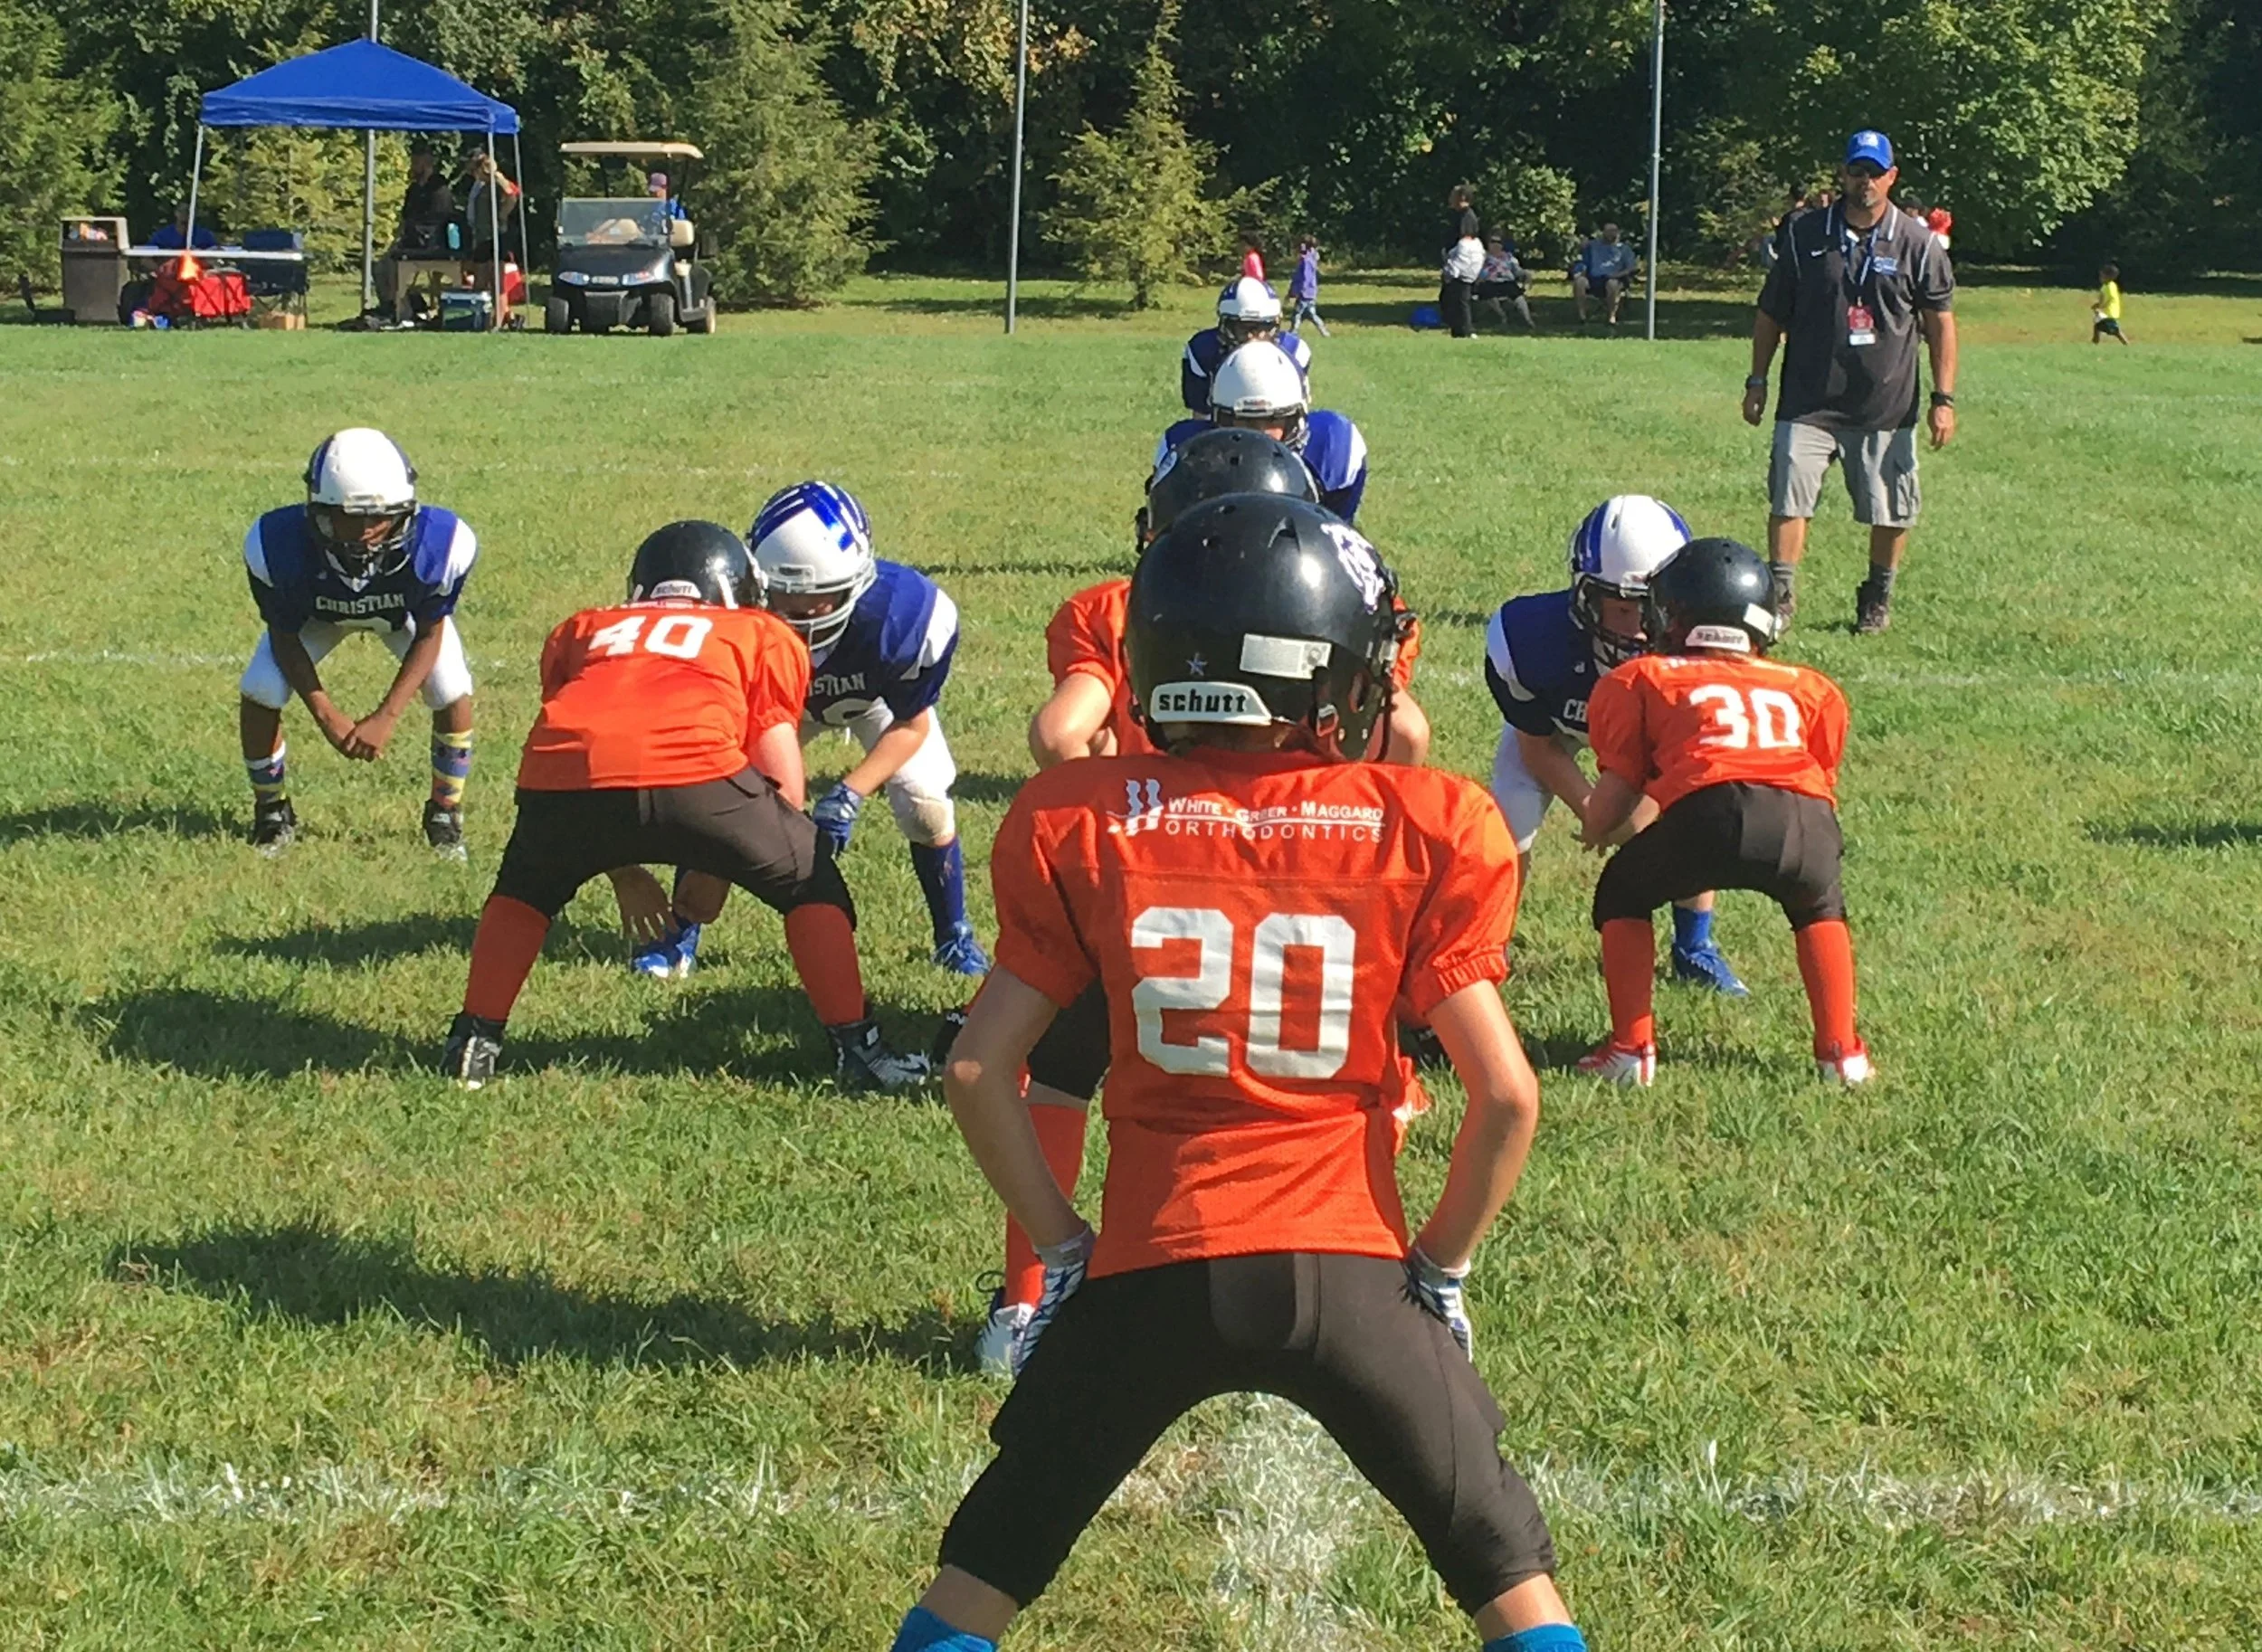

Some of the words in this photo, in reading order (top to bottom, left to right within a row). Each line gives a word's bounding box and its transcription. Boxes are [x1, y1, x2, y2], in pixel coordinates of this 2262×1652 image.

[315, 593, 405, 614] CHRISTIAN
[588, 614, 714, 659] 40
[809, 672, 866, 697] ISTIAN
[1159, 688, 1246, 713] schutt
[1688, 684, 1801, 749] 30
[1168, 797, 1223, 814] WHITE
[1300, 801, 1384, 820] MAGGARD
[1164, 821, 1383, 844] ORTHODONTICS
[1131, 907, 1355, 1079] 20
